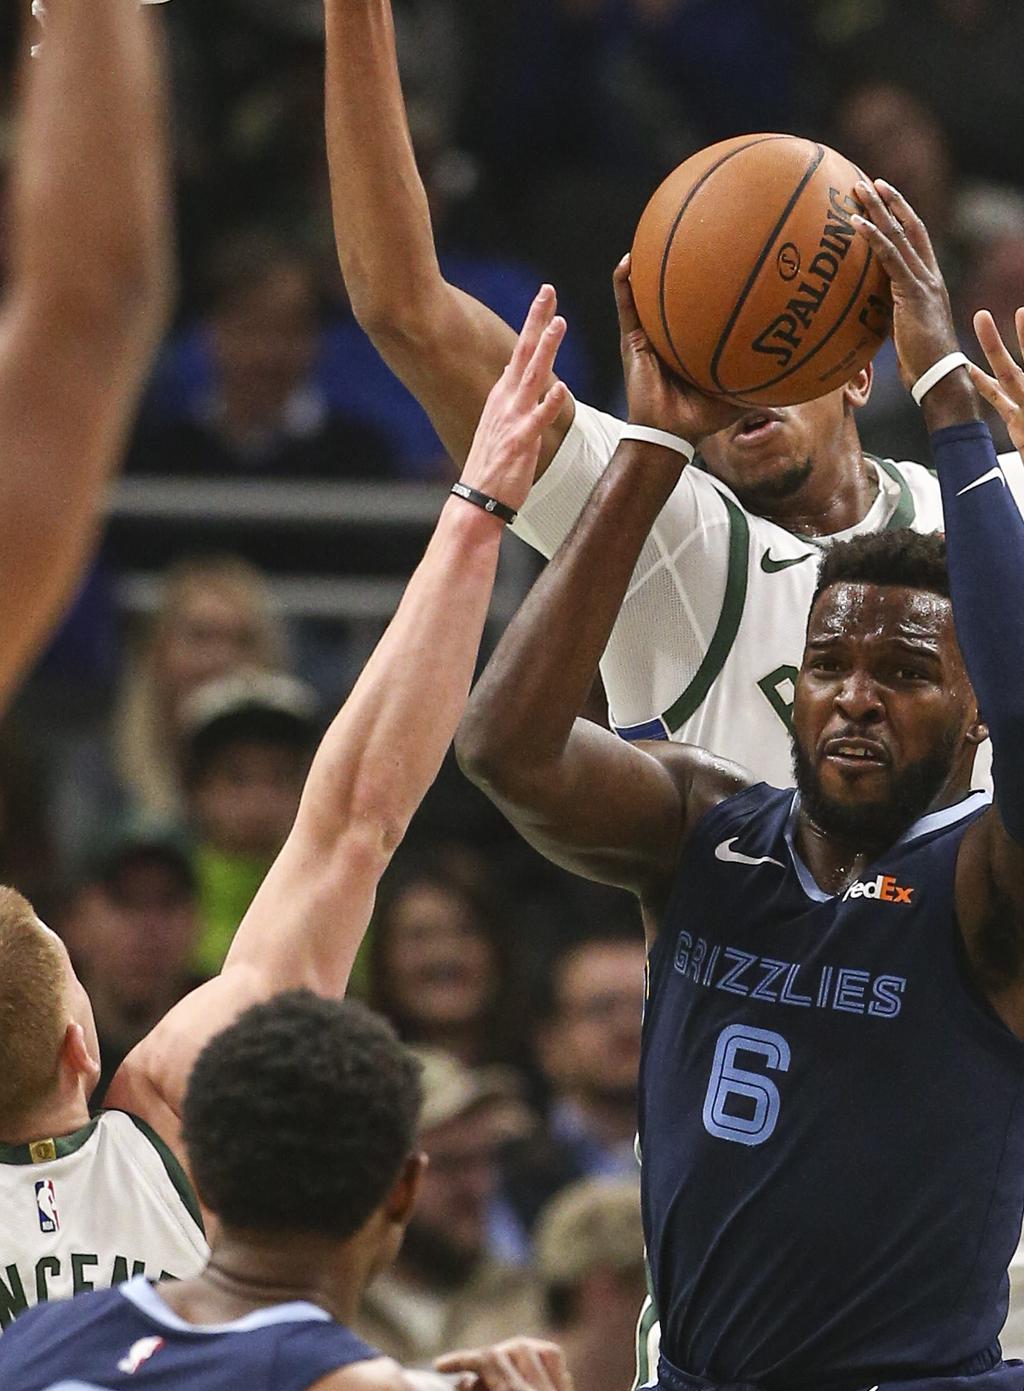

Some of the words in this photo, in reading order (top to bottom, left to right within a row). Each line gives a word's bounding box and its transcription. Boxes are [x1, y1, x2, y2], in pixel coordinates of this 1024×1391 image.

[752, 186, 864, 367] SPALDING
[673, 930, 908, 1019] GRIZZLIES
[702, 1023, 791, 1147] 6
